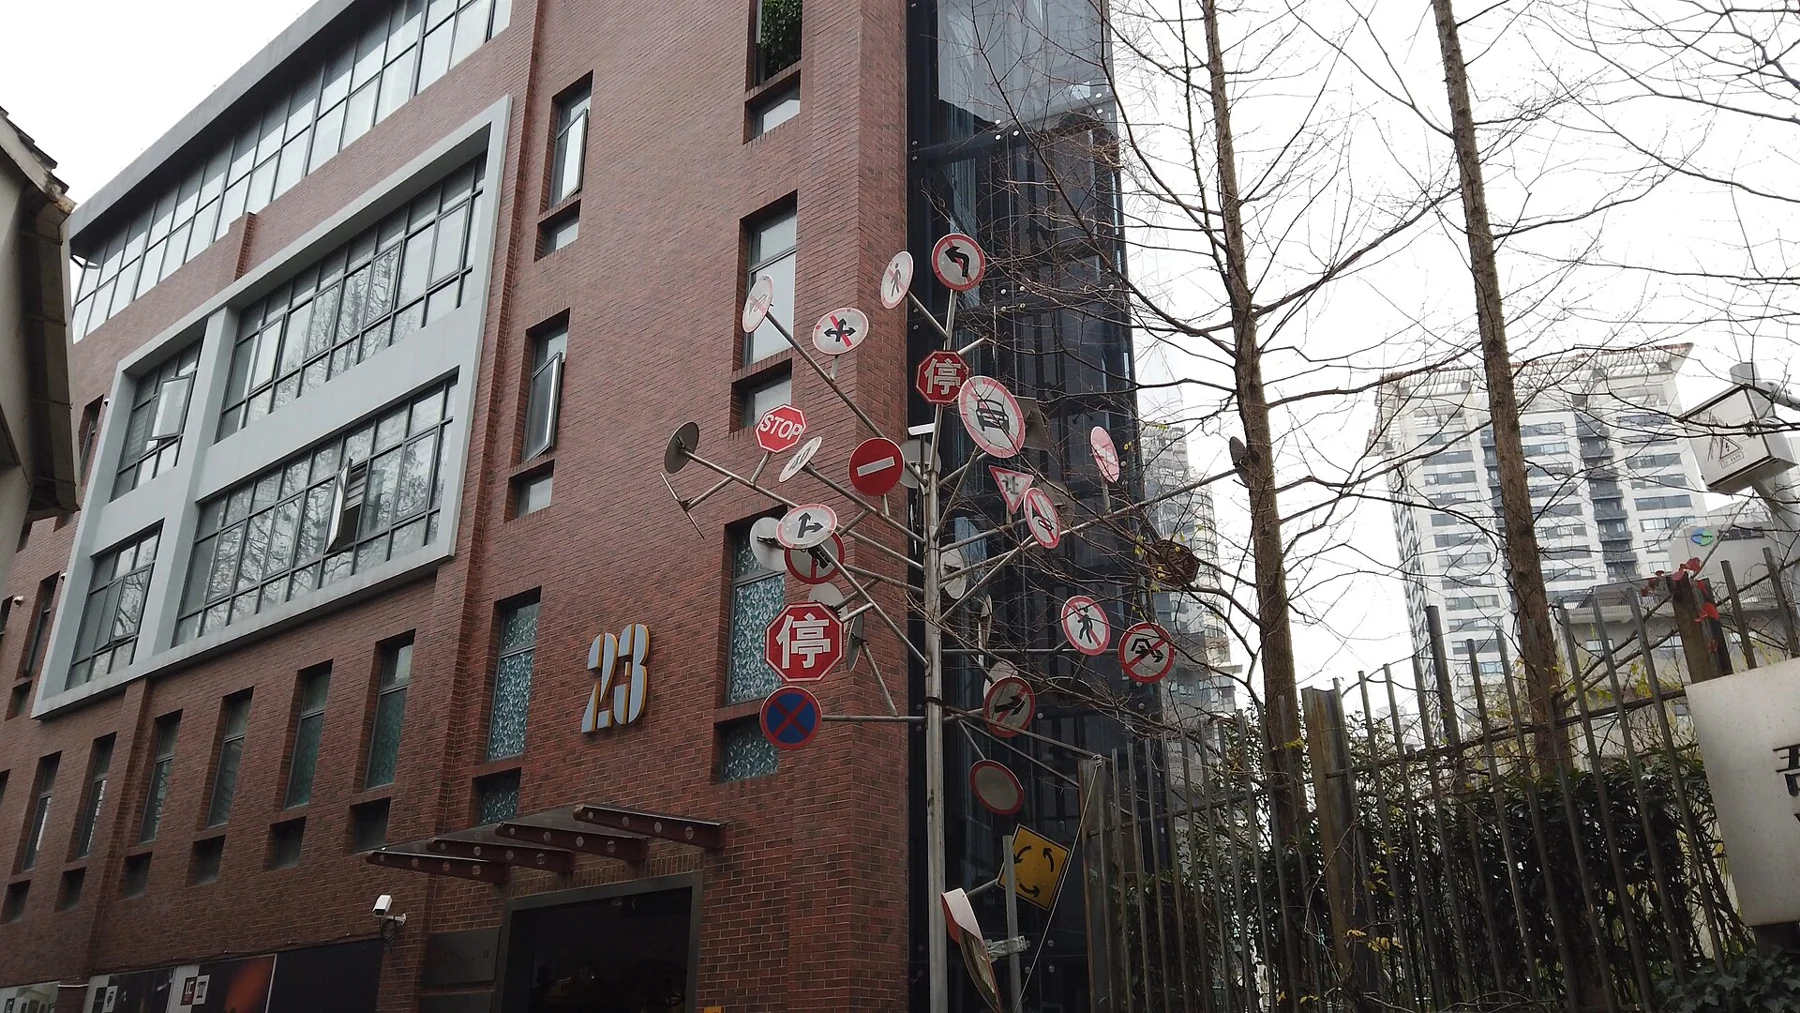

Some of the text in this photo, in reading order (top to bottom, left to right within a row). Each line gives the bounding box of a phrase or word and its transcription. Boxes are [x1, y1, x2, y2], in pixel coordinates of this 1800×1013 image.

[923, 357, 962, 395] 停
[759, 414, 804, 441] STOP
[775, 612, 831, 670] 停
[580, 622, 650, 734] 23
